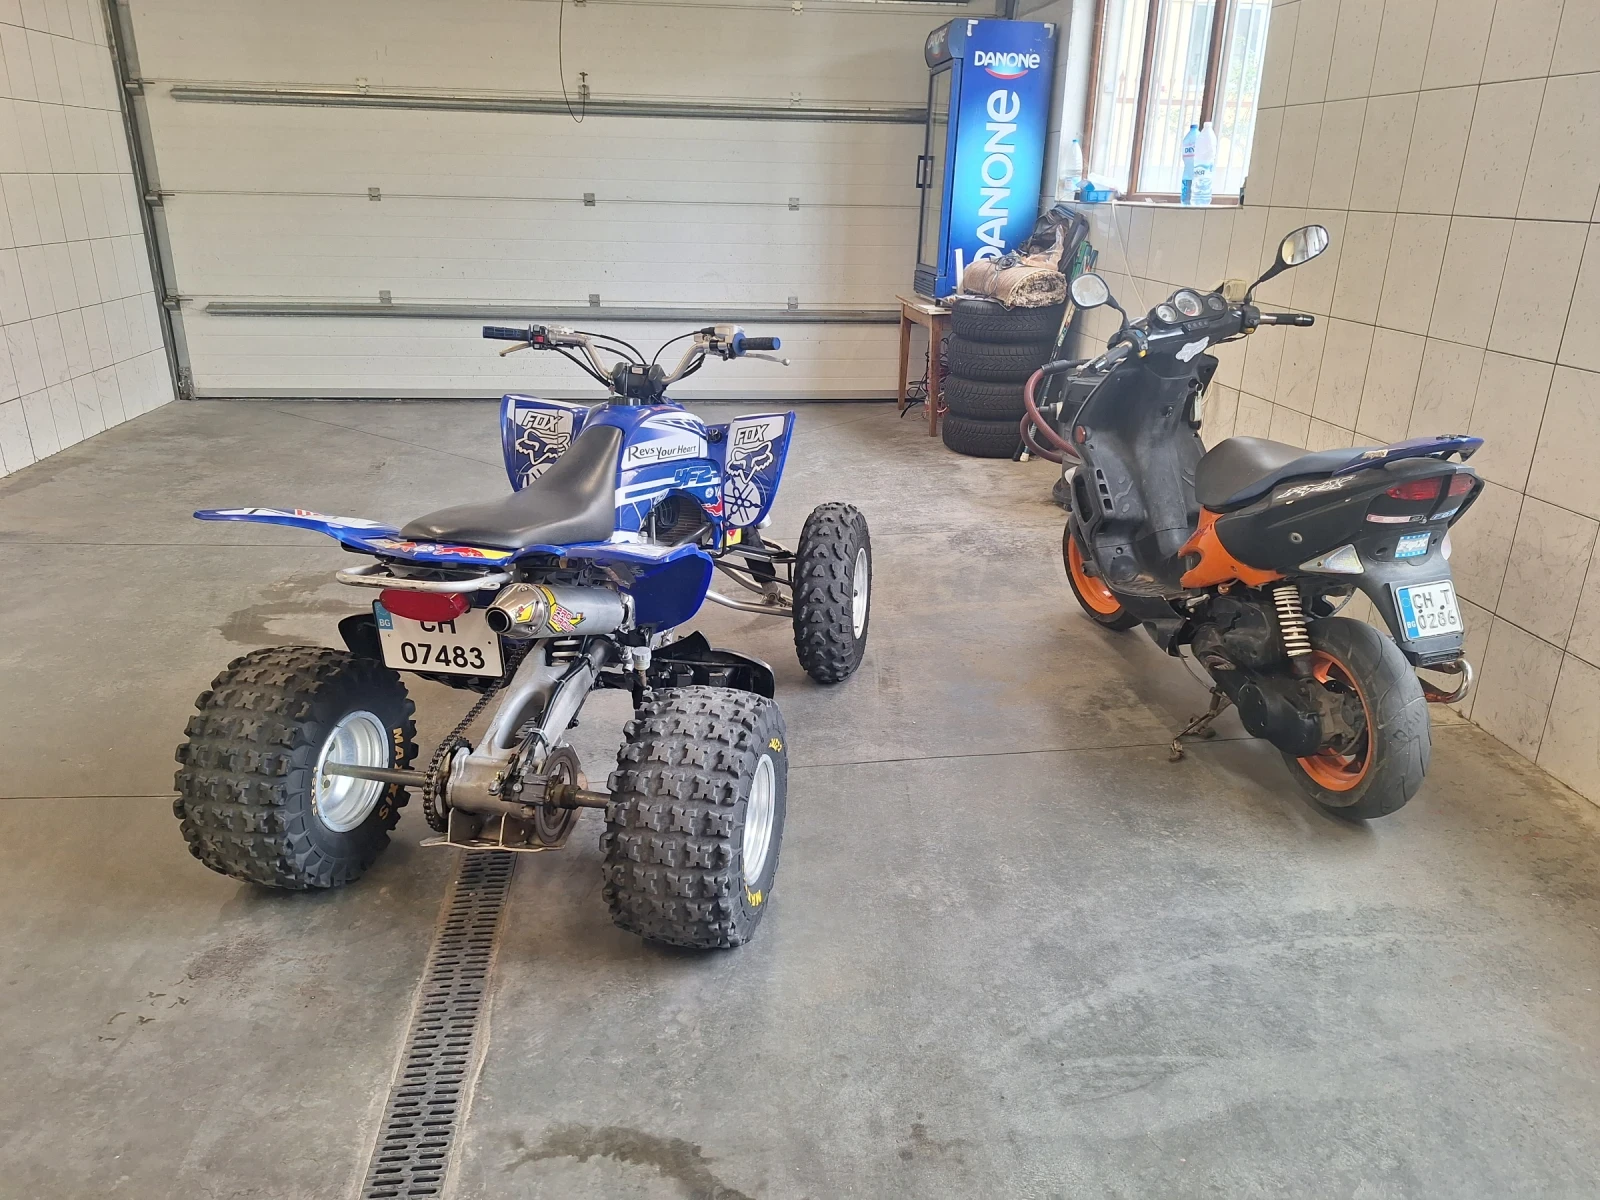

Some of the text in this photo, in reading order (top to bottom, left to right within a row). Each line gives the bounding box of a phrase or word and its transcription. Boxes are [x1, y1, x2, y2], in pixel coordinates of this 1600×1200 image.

[521, 410, 564, 432] FOX
[734, 423, 769, 446] FOX
[677, 445, 697, 455] Heart
[1413, 589, 1450, 609] CH T
[380, 619, 391, 627] BG
[555, 606, 574, 621] PRO
[1418, 610, 1457, 630] 0286
[1407, 621, 1416, 629] BG
[401, 642, 485, 669] 07483
